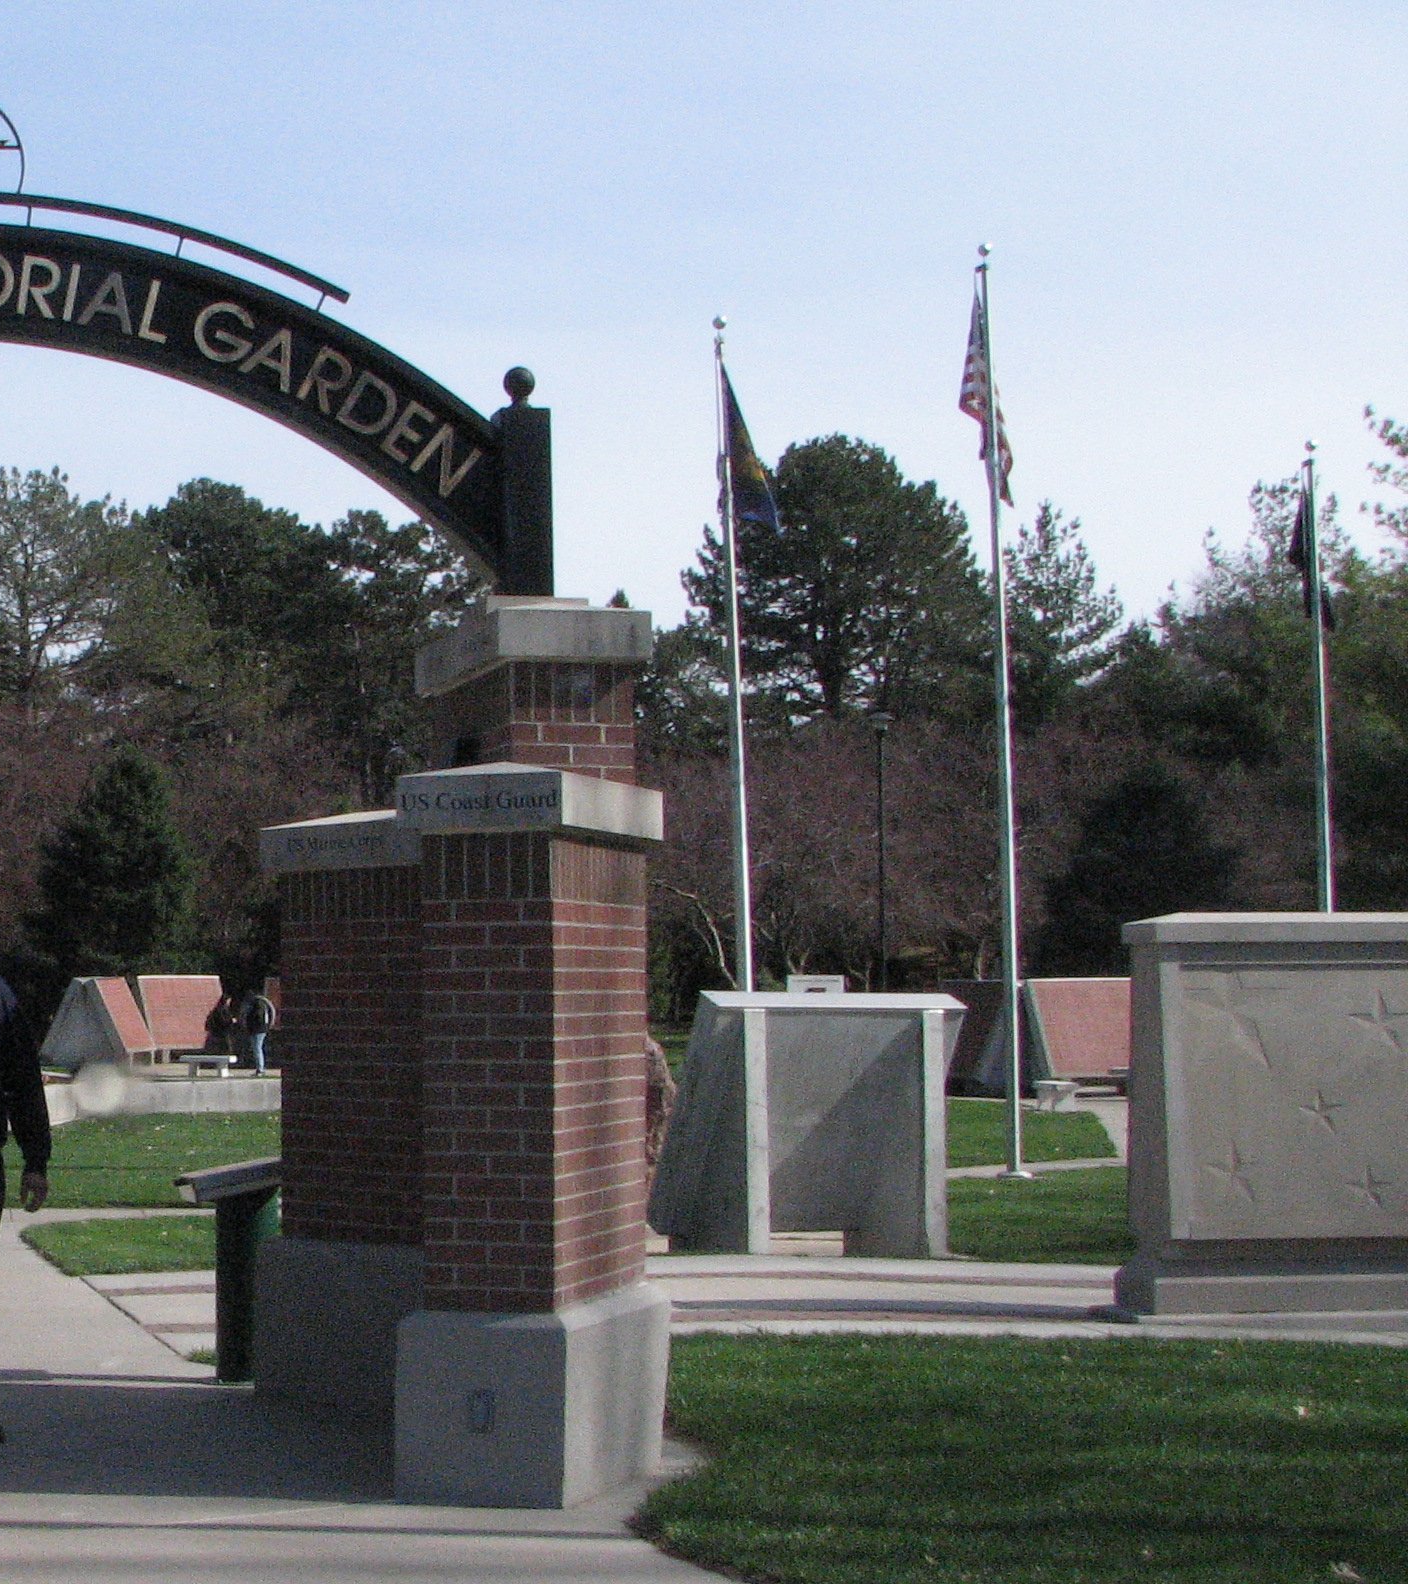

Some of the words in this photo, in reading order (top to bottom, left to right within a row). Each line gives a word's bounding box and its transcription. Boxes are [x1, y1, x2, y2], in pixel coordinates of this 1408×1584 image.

[193, 300, 481, 497] GARDEN
[401, 792, 429, 811] US
[435, 792, 491, 811] Coast
[496, 788, 557, 810] Guard
